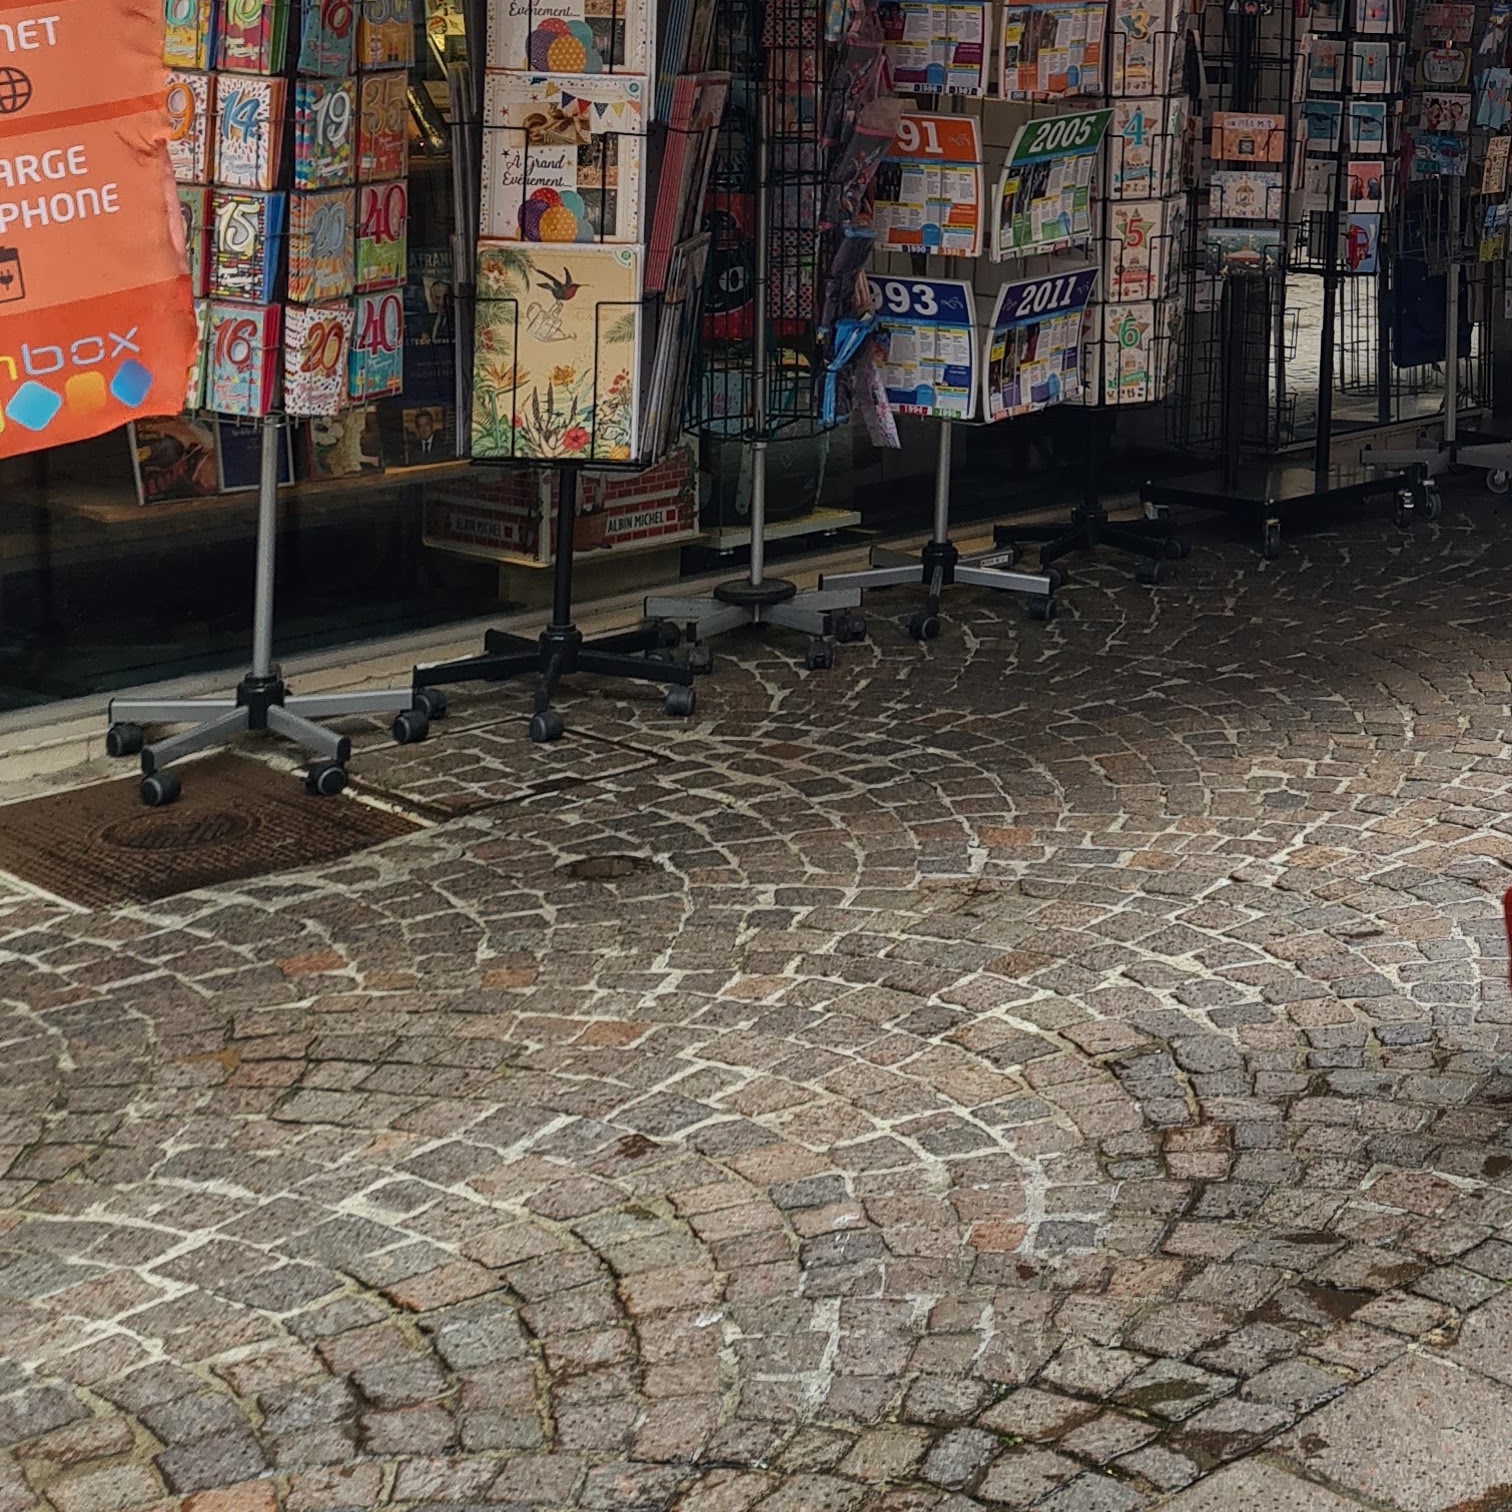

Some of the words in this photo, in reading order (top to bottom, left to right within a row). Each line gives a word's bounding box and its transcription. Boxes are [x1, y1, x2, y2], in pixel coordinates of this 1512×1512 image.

[167, 82, 196, 142] 9
[220, 89, 261, 143] 14
[312, 90, 350, 146] 19
[898, 119, 944, 154] 91
[1027, 115, 1092, 154] 2005
[1123, 110, 1145, 146] 4
[215, 200, 261, 255] 15
[359, 183, 407, 245] 40
[1126, 216, 1145, 249] 5
[213, 318, 258, 373] 16
[300, 321, 346, 376] 20
[356, 294, 402, 356] 40
[1014, 276, 1079, 318] 2011
[1118, 316, 1140, 349] 6
[607, 516, 633, 534] ALBIN
[635, 511, 664, 528] MICHEL
